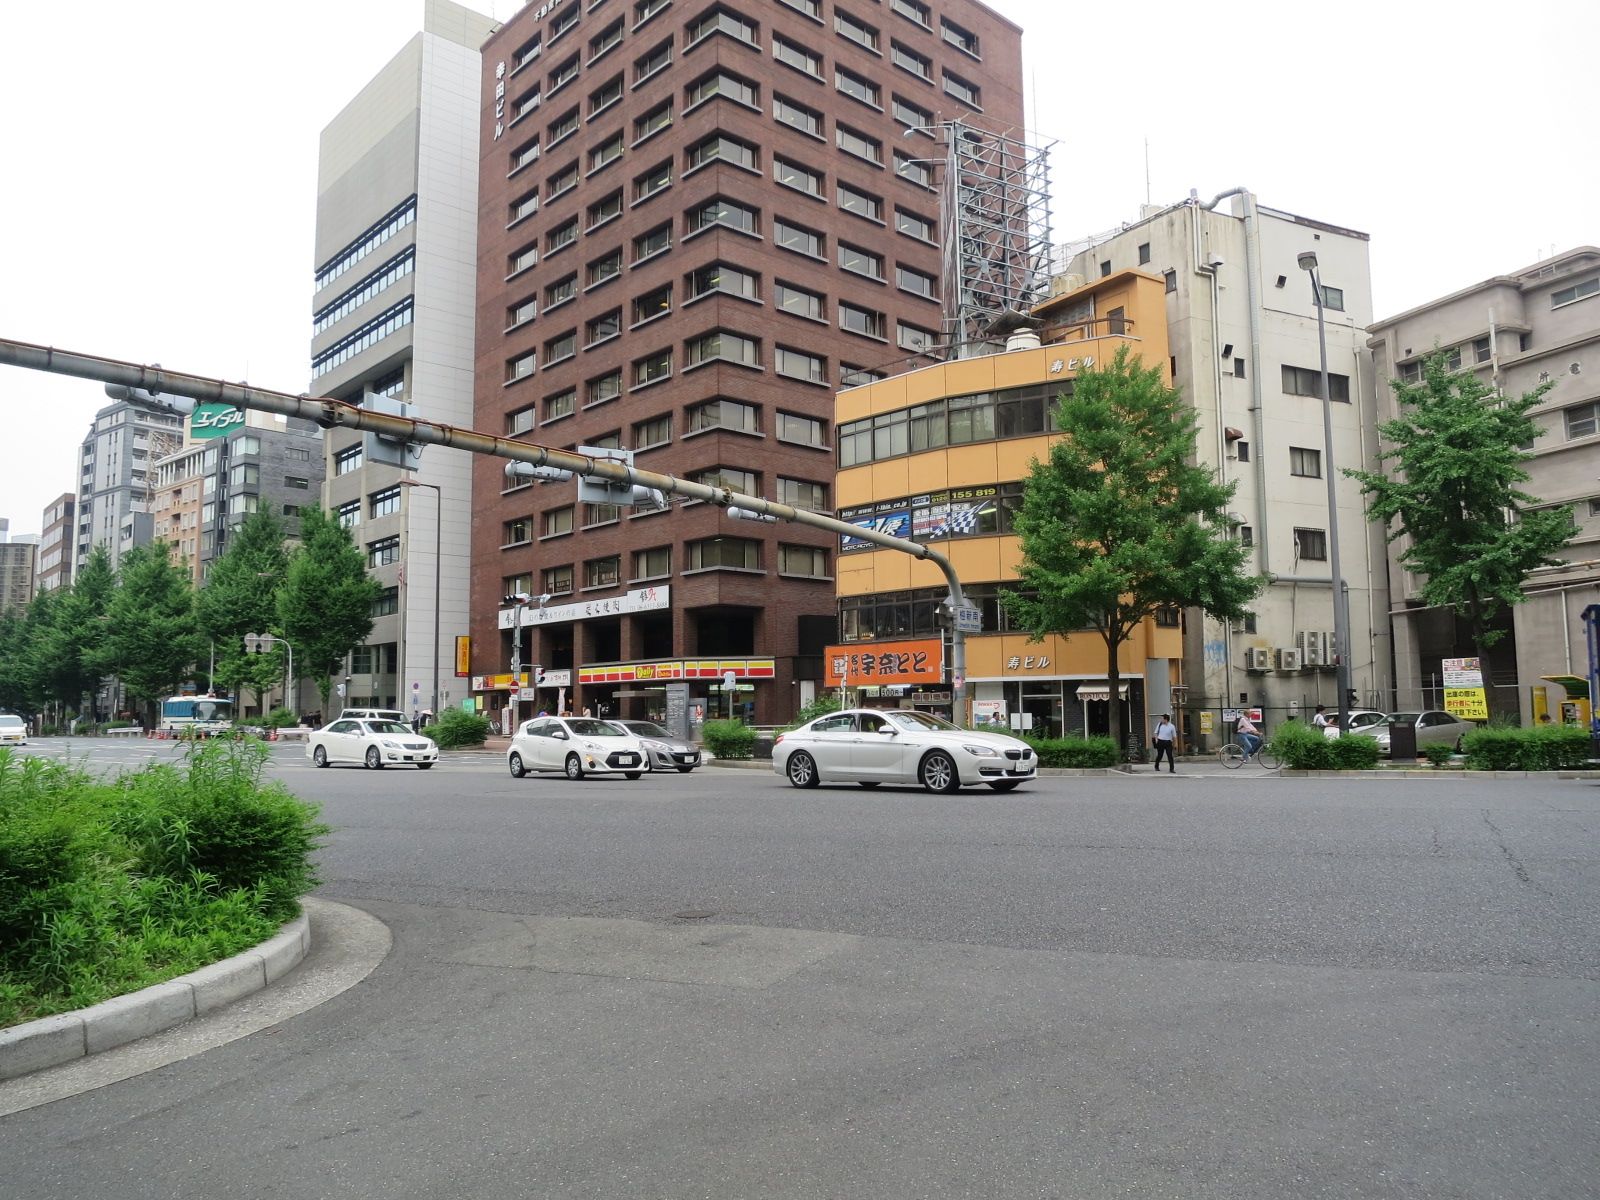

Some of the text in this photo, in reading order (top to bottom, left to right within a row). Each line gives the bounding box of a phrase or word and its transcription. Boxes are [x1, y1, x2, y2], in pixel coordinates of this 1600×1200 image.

[493, 61, 505, 141] 幸田ビル
[1050, 356, 1095, 373] 寿ビル
[192, 407, 245, 428] エイブル
[952, 490, 973, 499] 155
[975, 488, 996, 497] 819
[1007, 656, 1050, 669] 寿ビル
[636, 665, 654, 679] Daily
